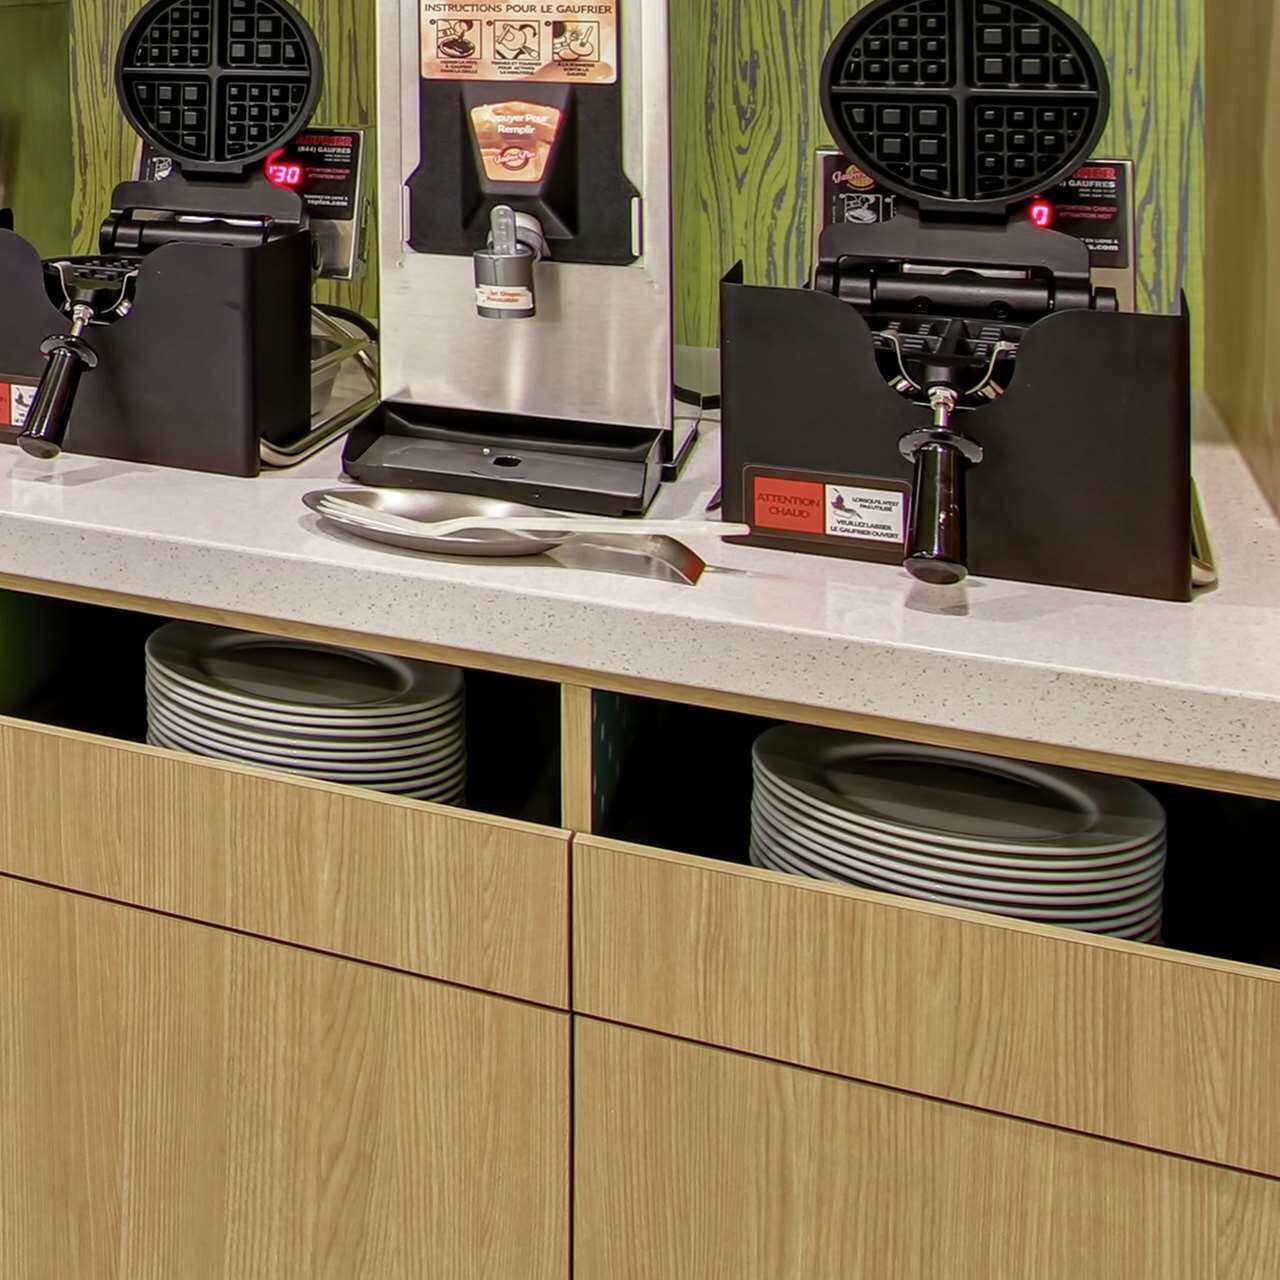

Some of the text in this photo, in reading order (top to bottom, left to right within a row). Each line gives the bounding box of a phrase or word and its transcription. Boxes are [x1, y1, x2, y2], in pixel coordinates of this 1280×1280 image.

[424, 3, 612, 15] INSTRUCTIONS POUR LE GAUFRIER
[497, 124, 536, 135] Remplir
[317, 146, 352, 154] GAUFRES
[1068, 179, 1116, 188] GAUFRES
[756, 493, 820, 507] ATTENTION
[768, 506, 810, 519] CHAUD
[872, 531, 899, 539] OUVERT
